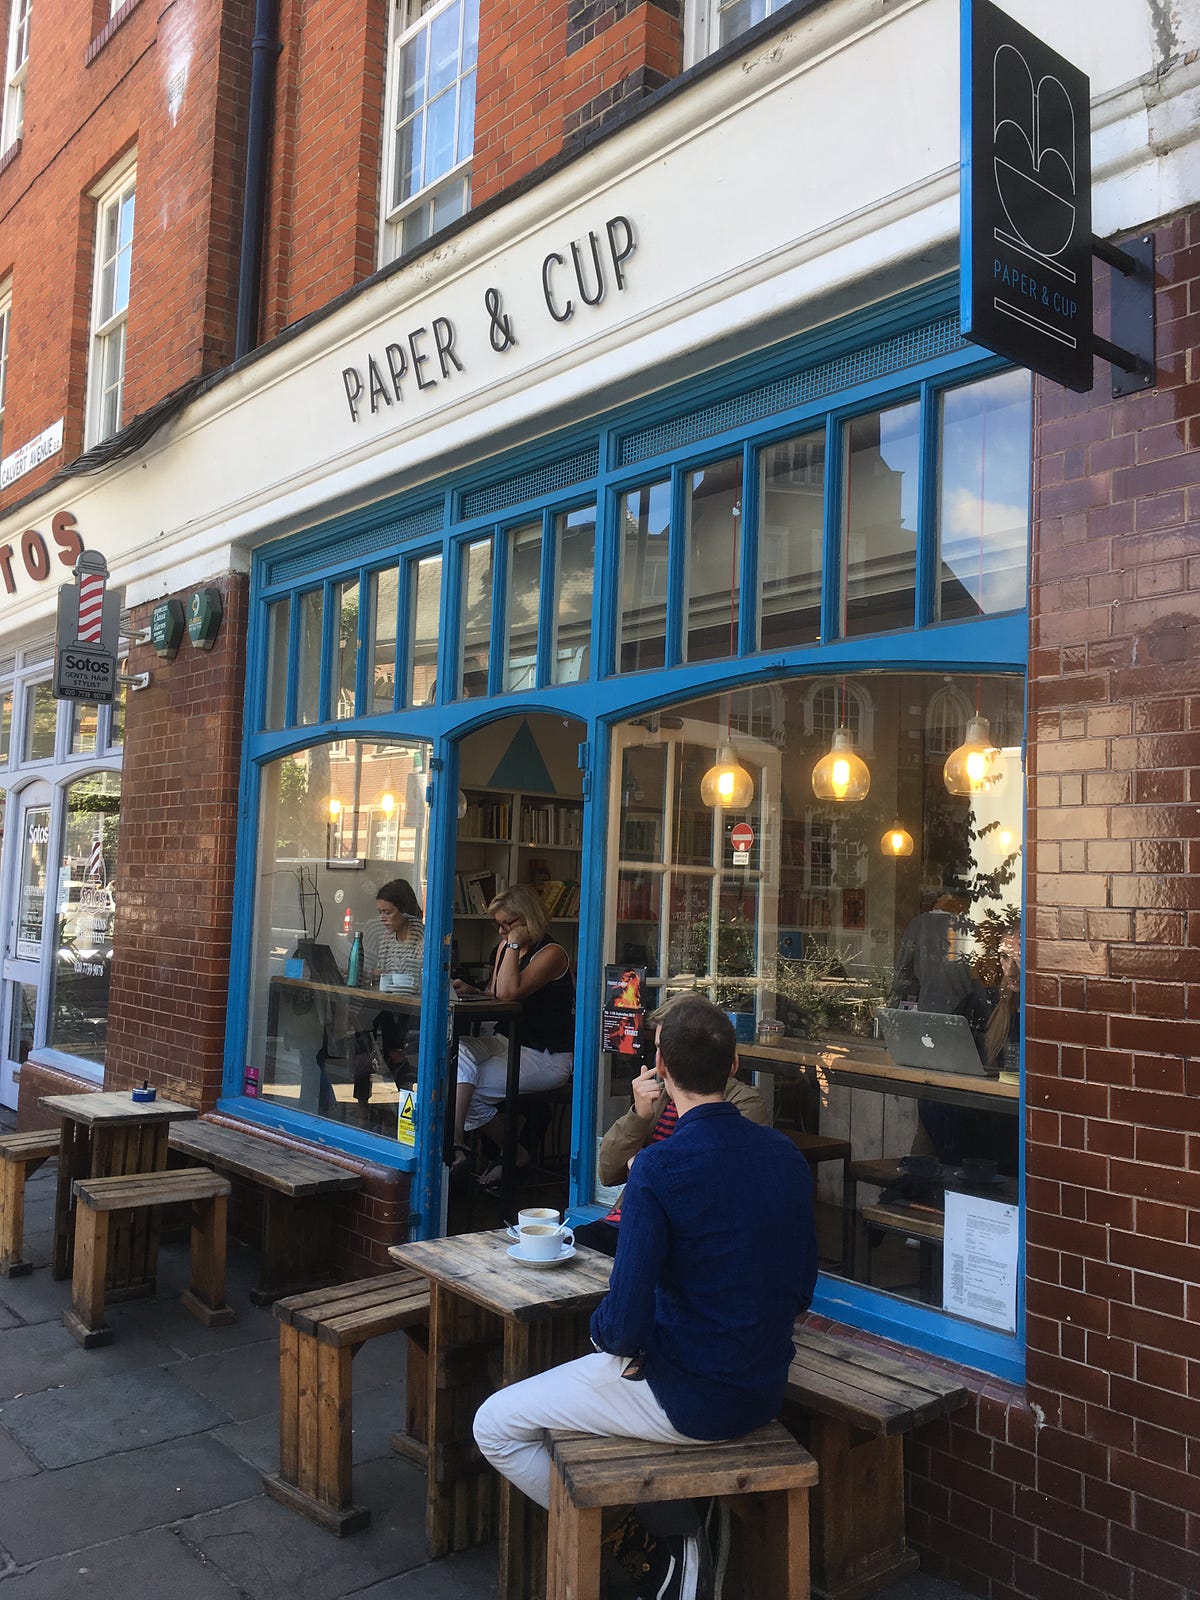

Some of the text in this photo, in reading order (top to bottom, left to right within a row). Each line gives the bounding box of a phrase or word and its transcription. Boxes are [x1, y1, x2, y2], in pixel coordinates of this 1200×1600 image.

[994, 258, 1077, 320] PAPER & CUP
[342, 215, 636, 423] PAPER & CUP
[1, 455, 27, 485] CALVERT
[30, 437, 53, 466] AVENUE
[66, 655, 109, 674] Sotos
[65, 671, 88, 680] GENTS
[73, 679, 101, 688] STYLIST
[29, 825, 49, 844] Sotos
